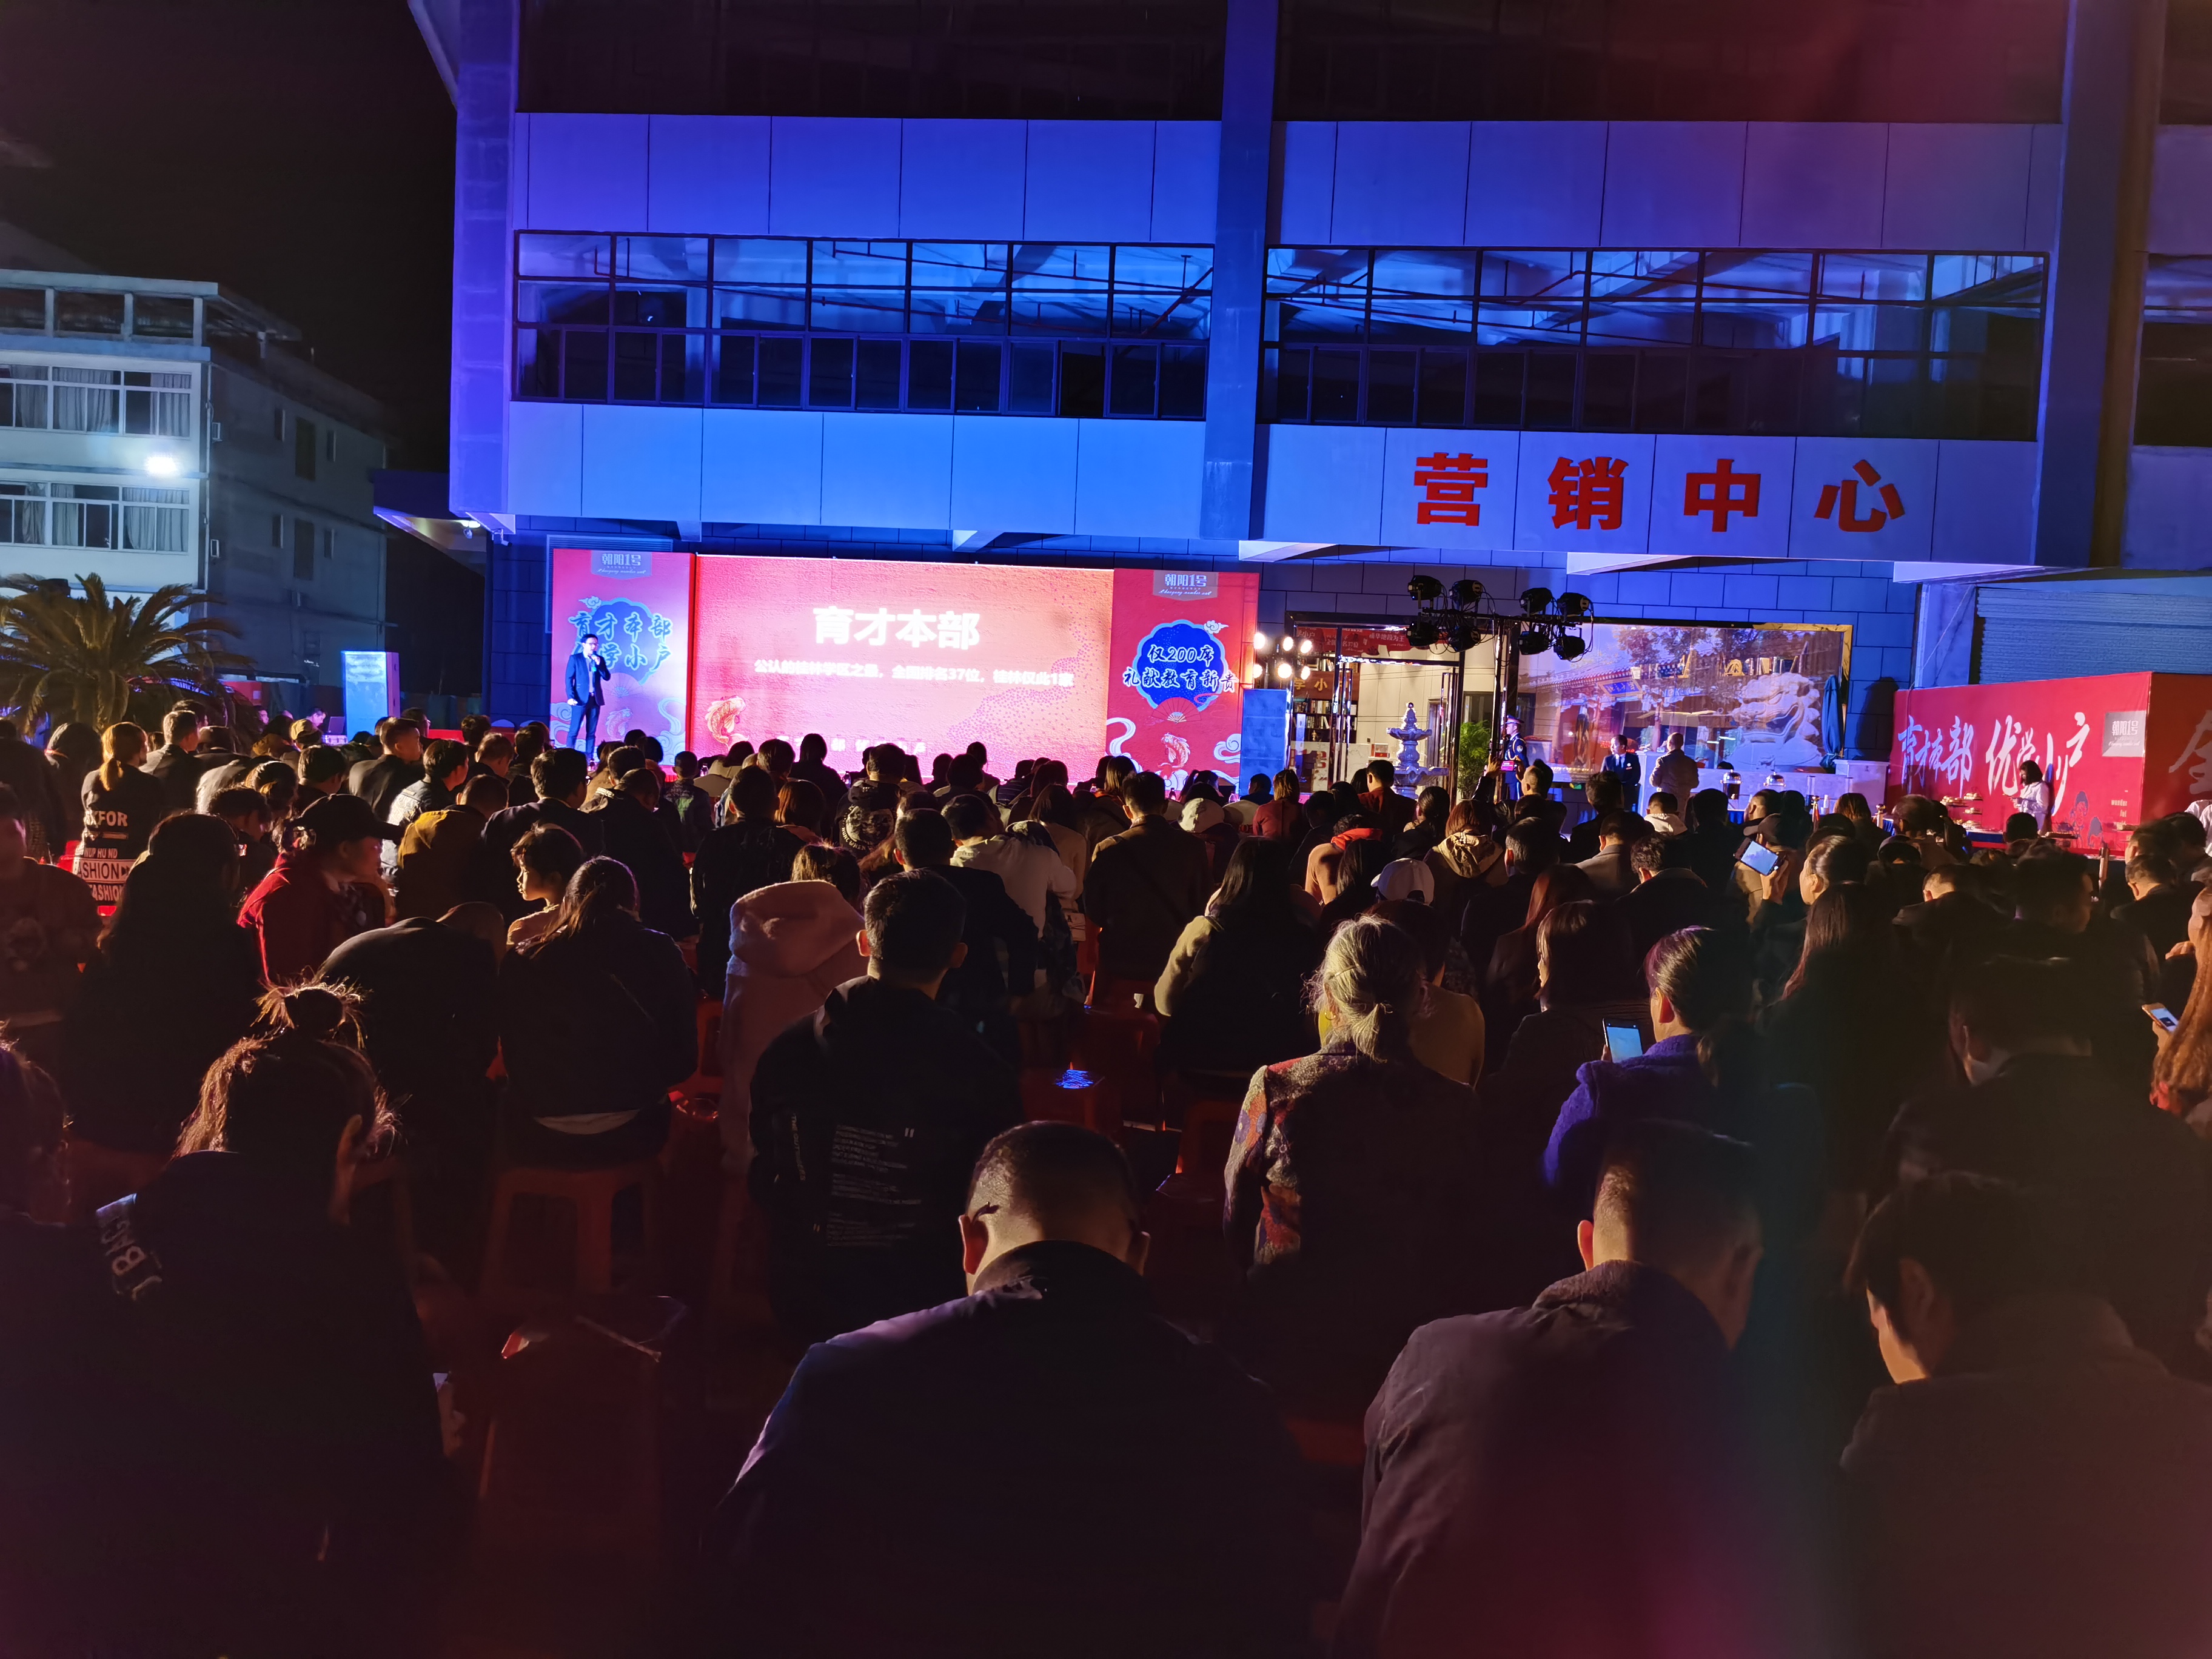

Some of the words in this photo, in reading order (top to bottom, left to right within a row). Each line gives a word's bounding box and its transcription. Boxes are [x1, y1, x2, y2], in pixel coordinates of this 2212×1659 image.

[1413, 452, 1905, 532] 营销中心
[602, 553, 642, 566] 朝阳1号
[1165, 574, 1207, 587] 朝阳1号
[568, 611, 673, 643] 育才本部
[813, 605, 980, 651] 育才本部
[1147, 644, 1215, 668] 仅200席
[1122, 666, 1238, 692] 礼献教育新贵
